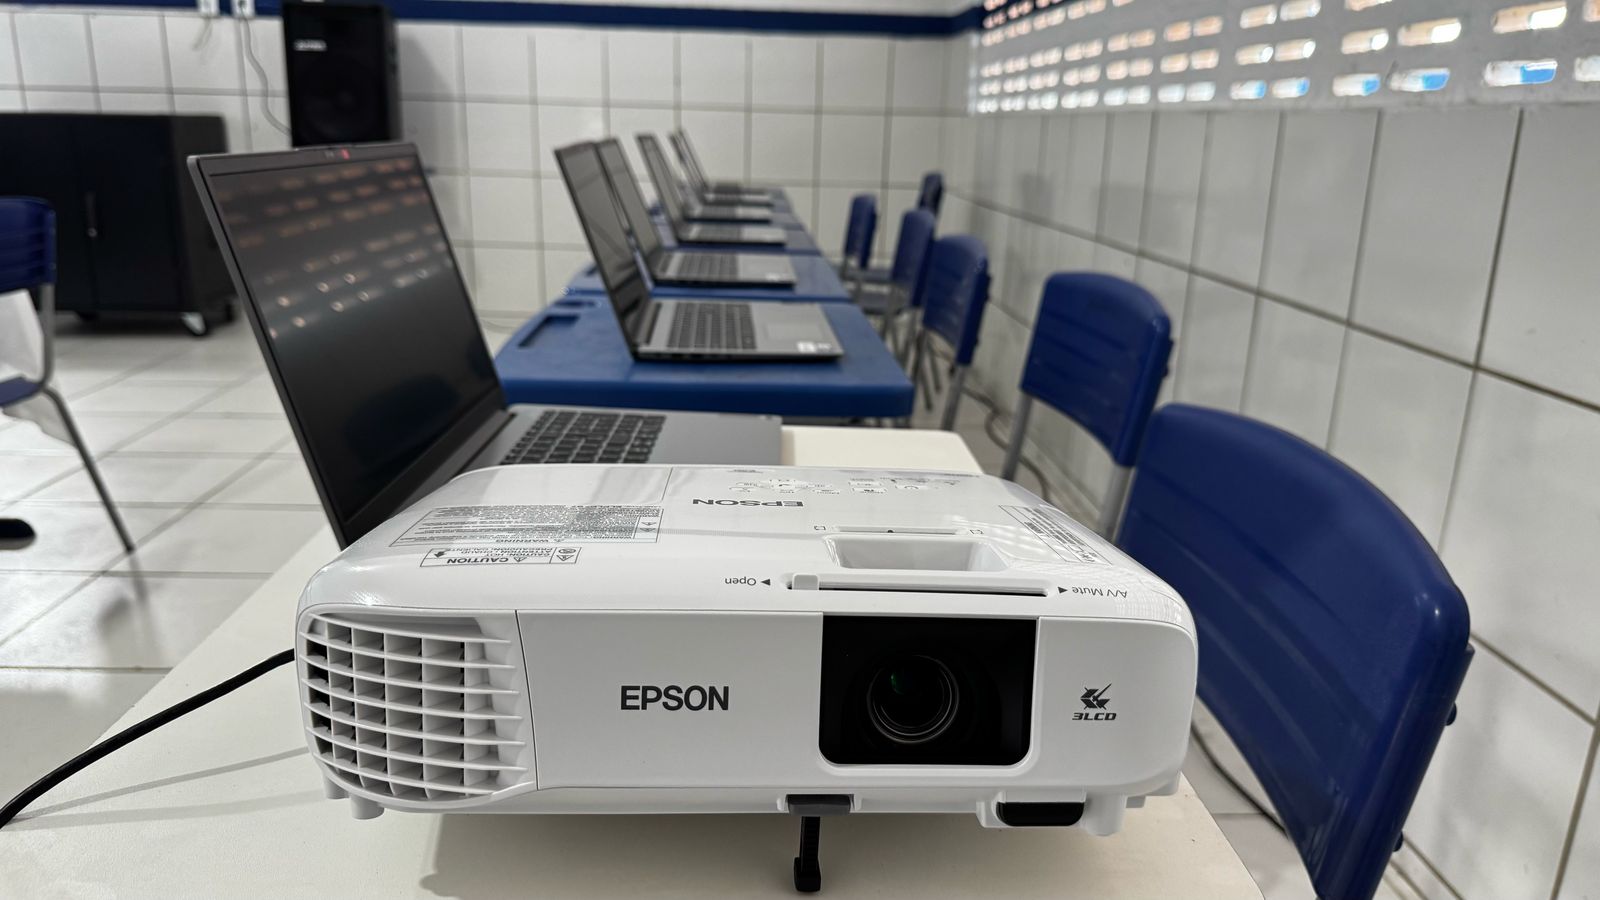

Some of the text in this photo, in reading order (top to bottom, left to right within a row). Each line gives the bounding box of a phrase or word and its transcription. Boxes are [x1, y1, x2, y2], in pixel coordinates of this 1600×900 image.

[692, 499, 803, 507] EPSON
[724, 576, 757, 586] Open
[1071, 586, 1128, 599] A/V Mute
[620, 685, 729, 711] EPSON
[1072, 712, 1117, 721] 3LCD
